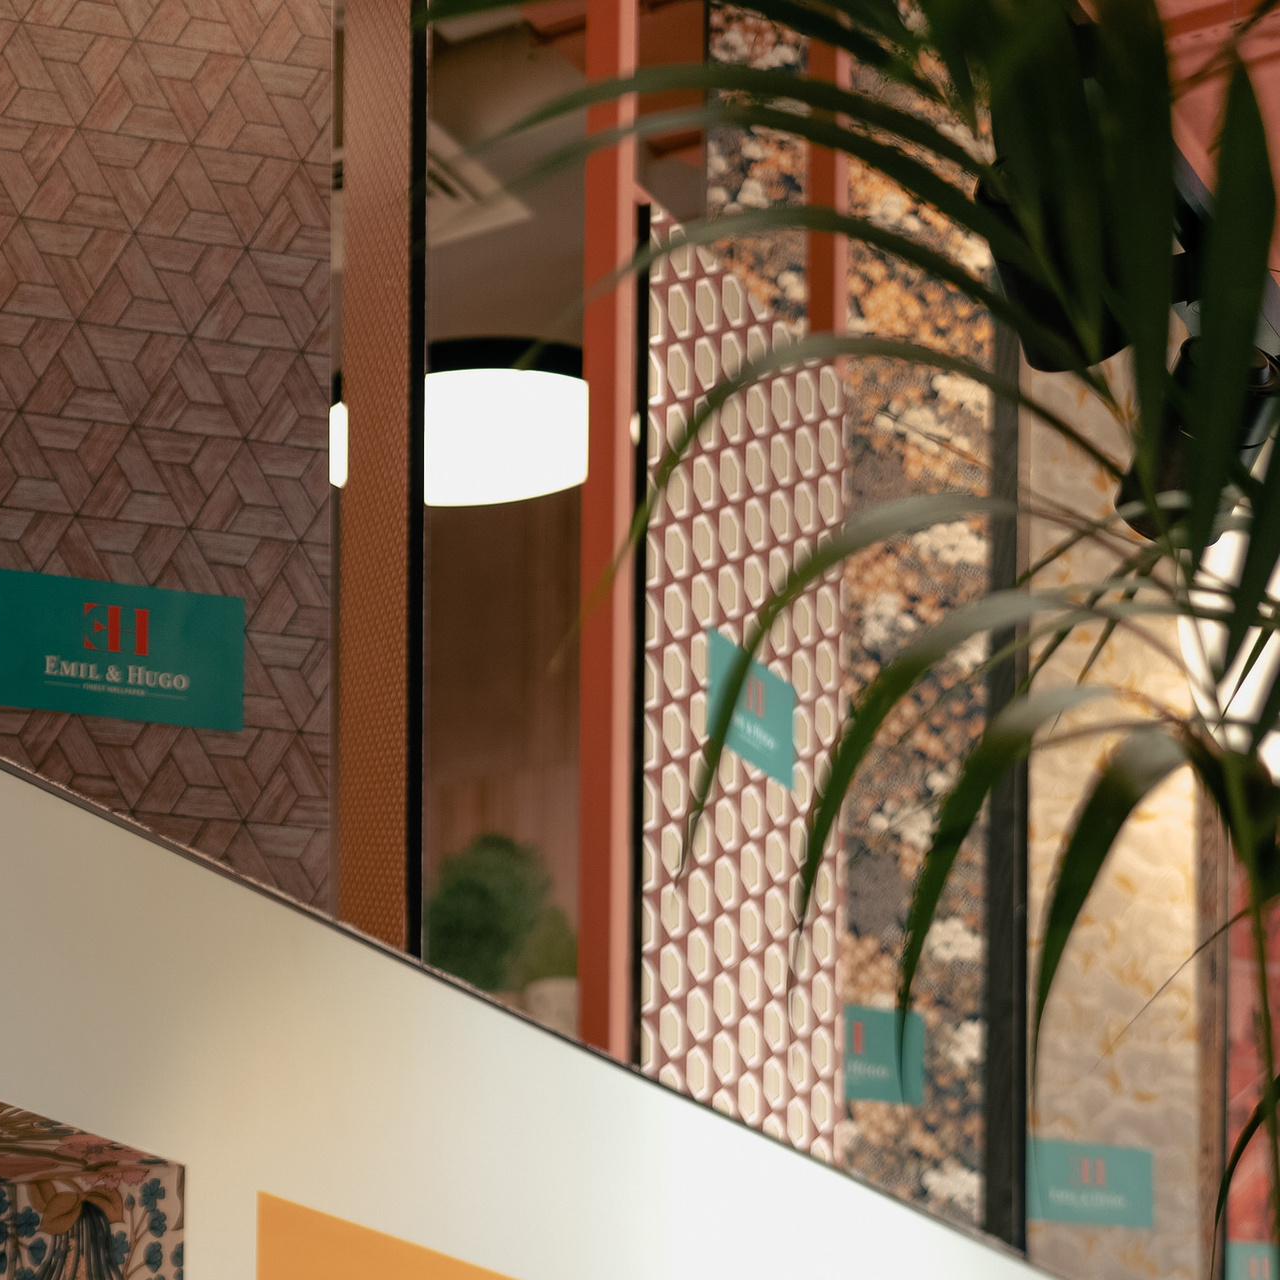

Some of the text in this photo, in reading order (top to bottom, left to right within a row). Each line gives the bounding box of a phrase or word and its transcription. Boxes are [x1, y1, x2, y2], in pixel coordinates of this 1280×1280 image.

[44, 654, 191, 691] EMIL & HUGO
[106, 685, 146, 697] WALLPAPER
